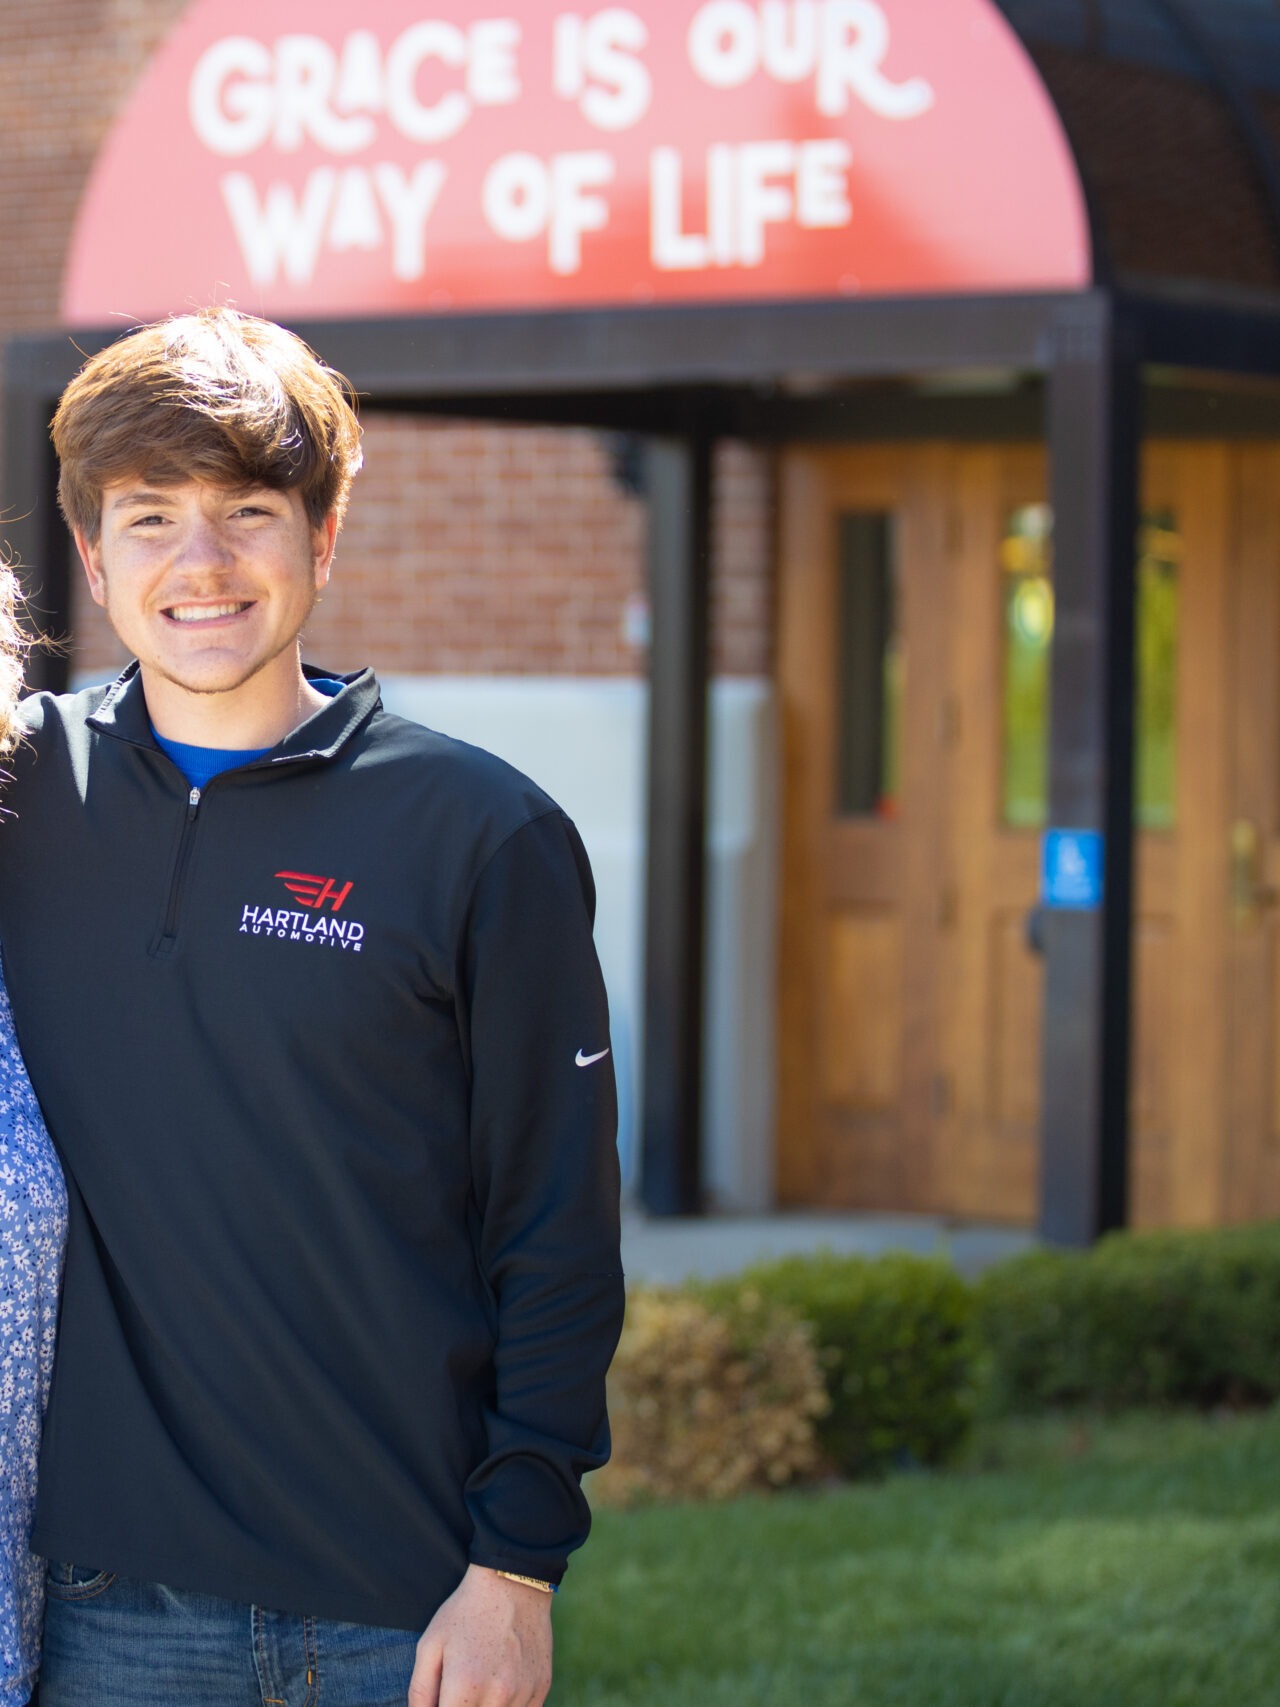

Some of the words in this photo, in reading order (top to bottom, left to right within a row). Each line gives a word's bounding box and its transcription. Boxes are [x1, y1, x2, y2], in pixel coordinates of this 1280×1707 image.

[191, 20, 520, 155] GRACE
[554, 8, 651, 131] IS
[688, 0, 934, 119] OUR
[223, 159, 446, 288] WAY
[483, 151, 614, 275] OF
[651, 139, 852, 271] LIFE
[239, 923, 362, 951] AUTOMOTIVE
[242, 904, 363, 940] HARTLAND
